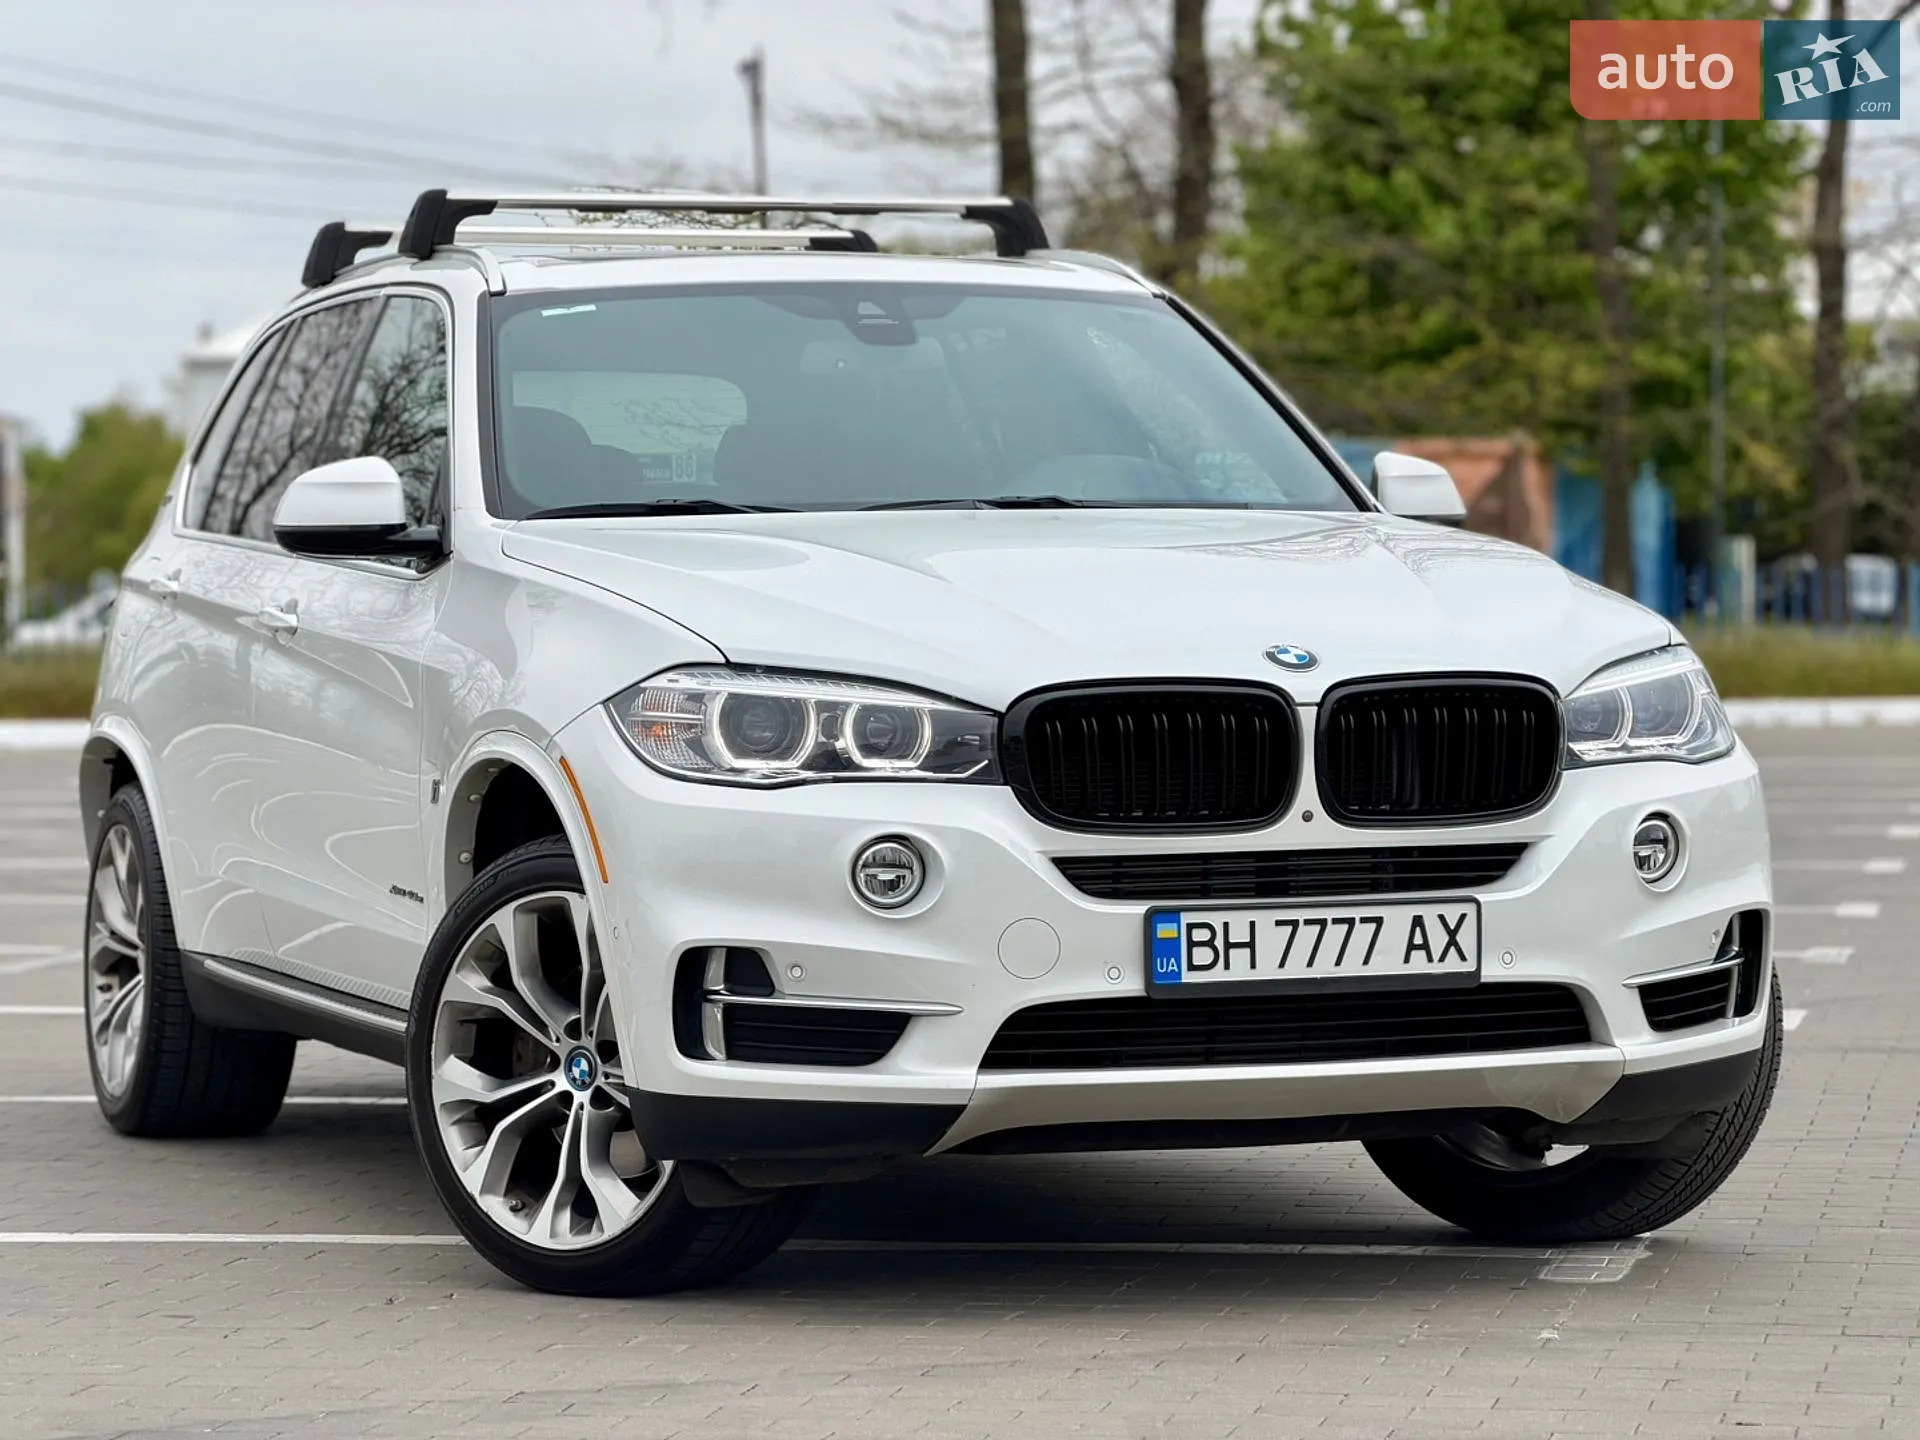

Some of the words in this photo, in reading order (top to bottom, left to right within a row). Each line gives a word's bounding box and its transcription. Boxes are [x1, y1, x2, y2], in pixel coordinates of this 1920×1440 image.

[1185, 919, 1257, 972] BH
[1274, 916, 1385, 969] 7777
[1403, 912, 1468, 964] AX
[1157, 957, 1179, 974] UA
